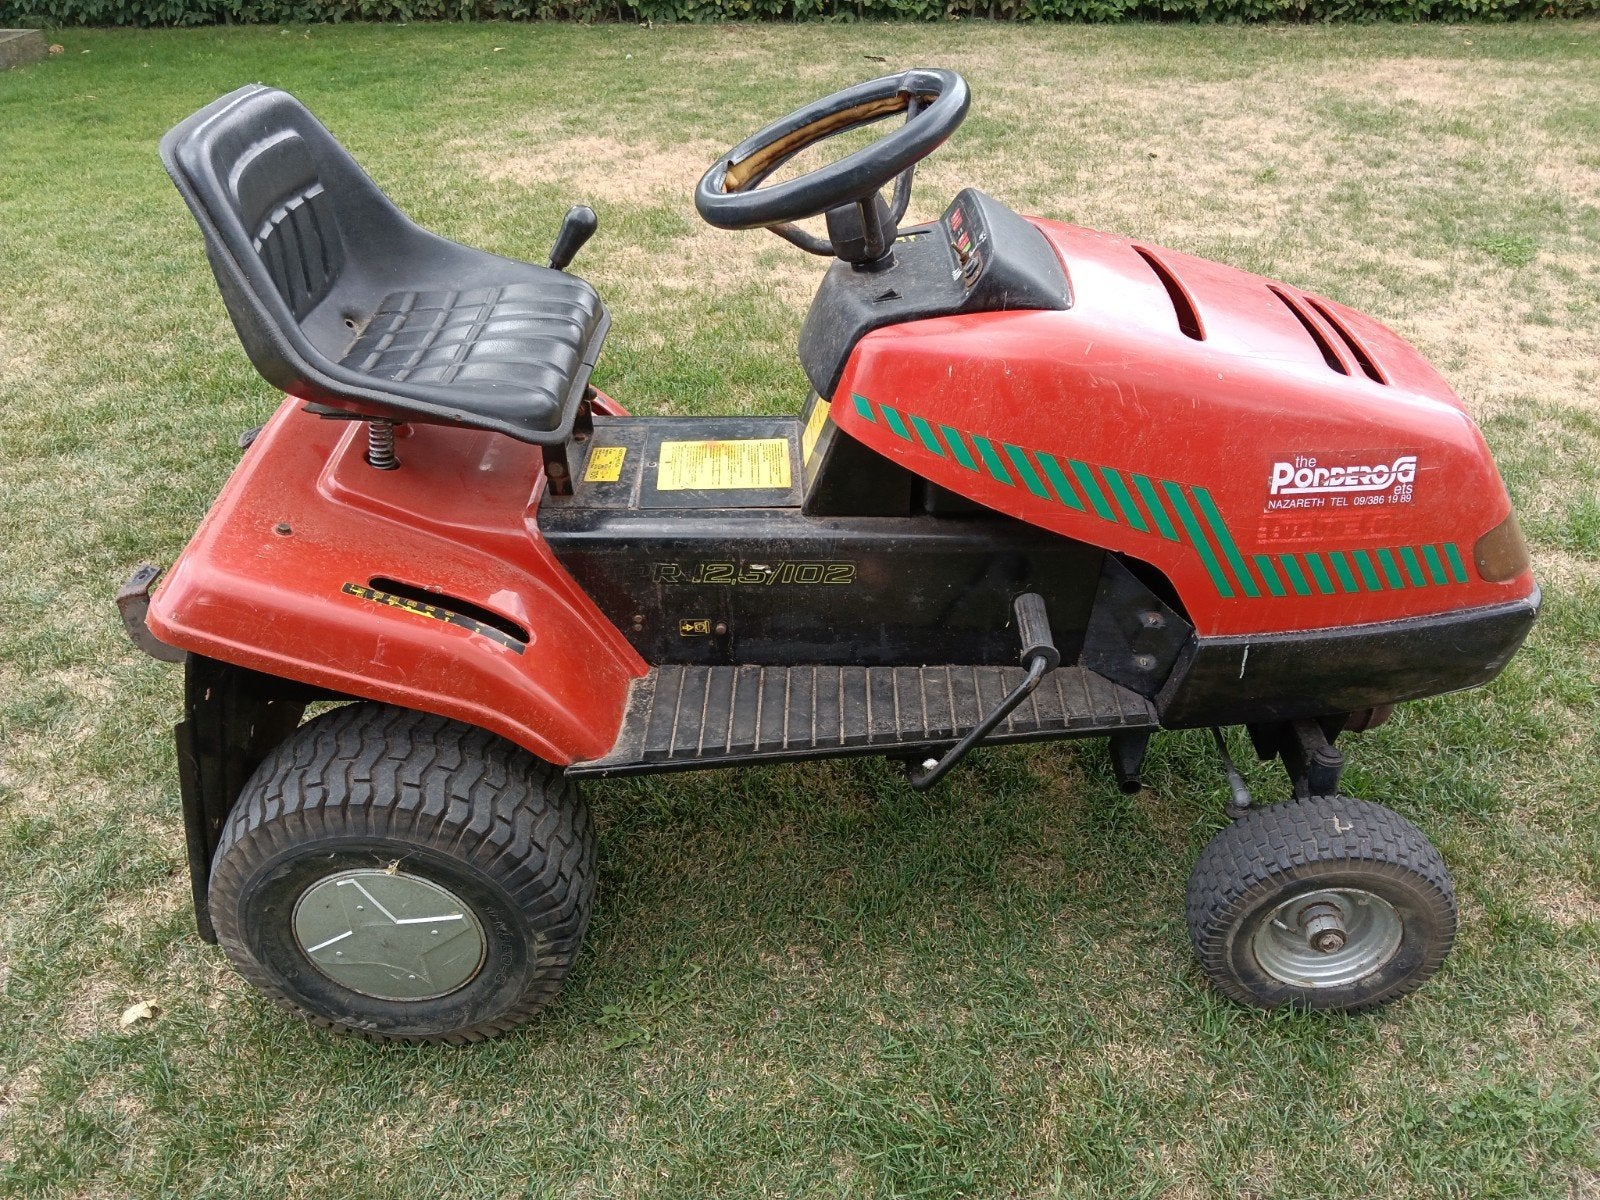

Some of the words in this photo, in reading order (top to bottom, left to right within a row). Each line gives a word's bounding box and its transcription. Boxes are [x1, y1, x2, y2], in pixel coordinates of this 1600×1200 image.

[1295, 456, 1317, 468] the
[1394, 483, 1413, 496] ets
[1268, 498, 1325, 510] NAZARETH
[1331, 497, 1349, 507] TEL
[1353, 495, 1385, 506] 09/386
[1387, 495, 1398, 504] 19
[1400, 494, 1412, 503] 89
